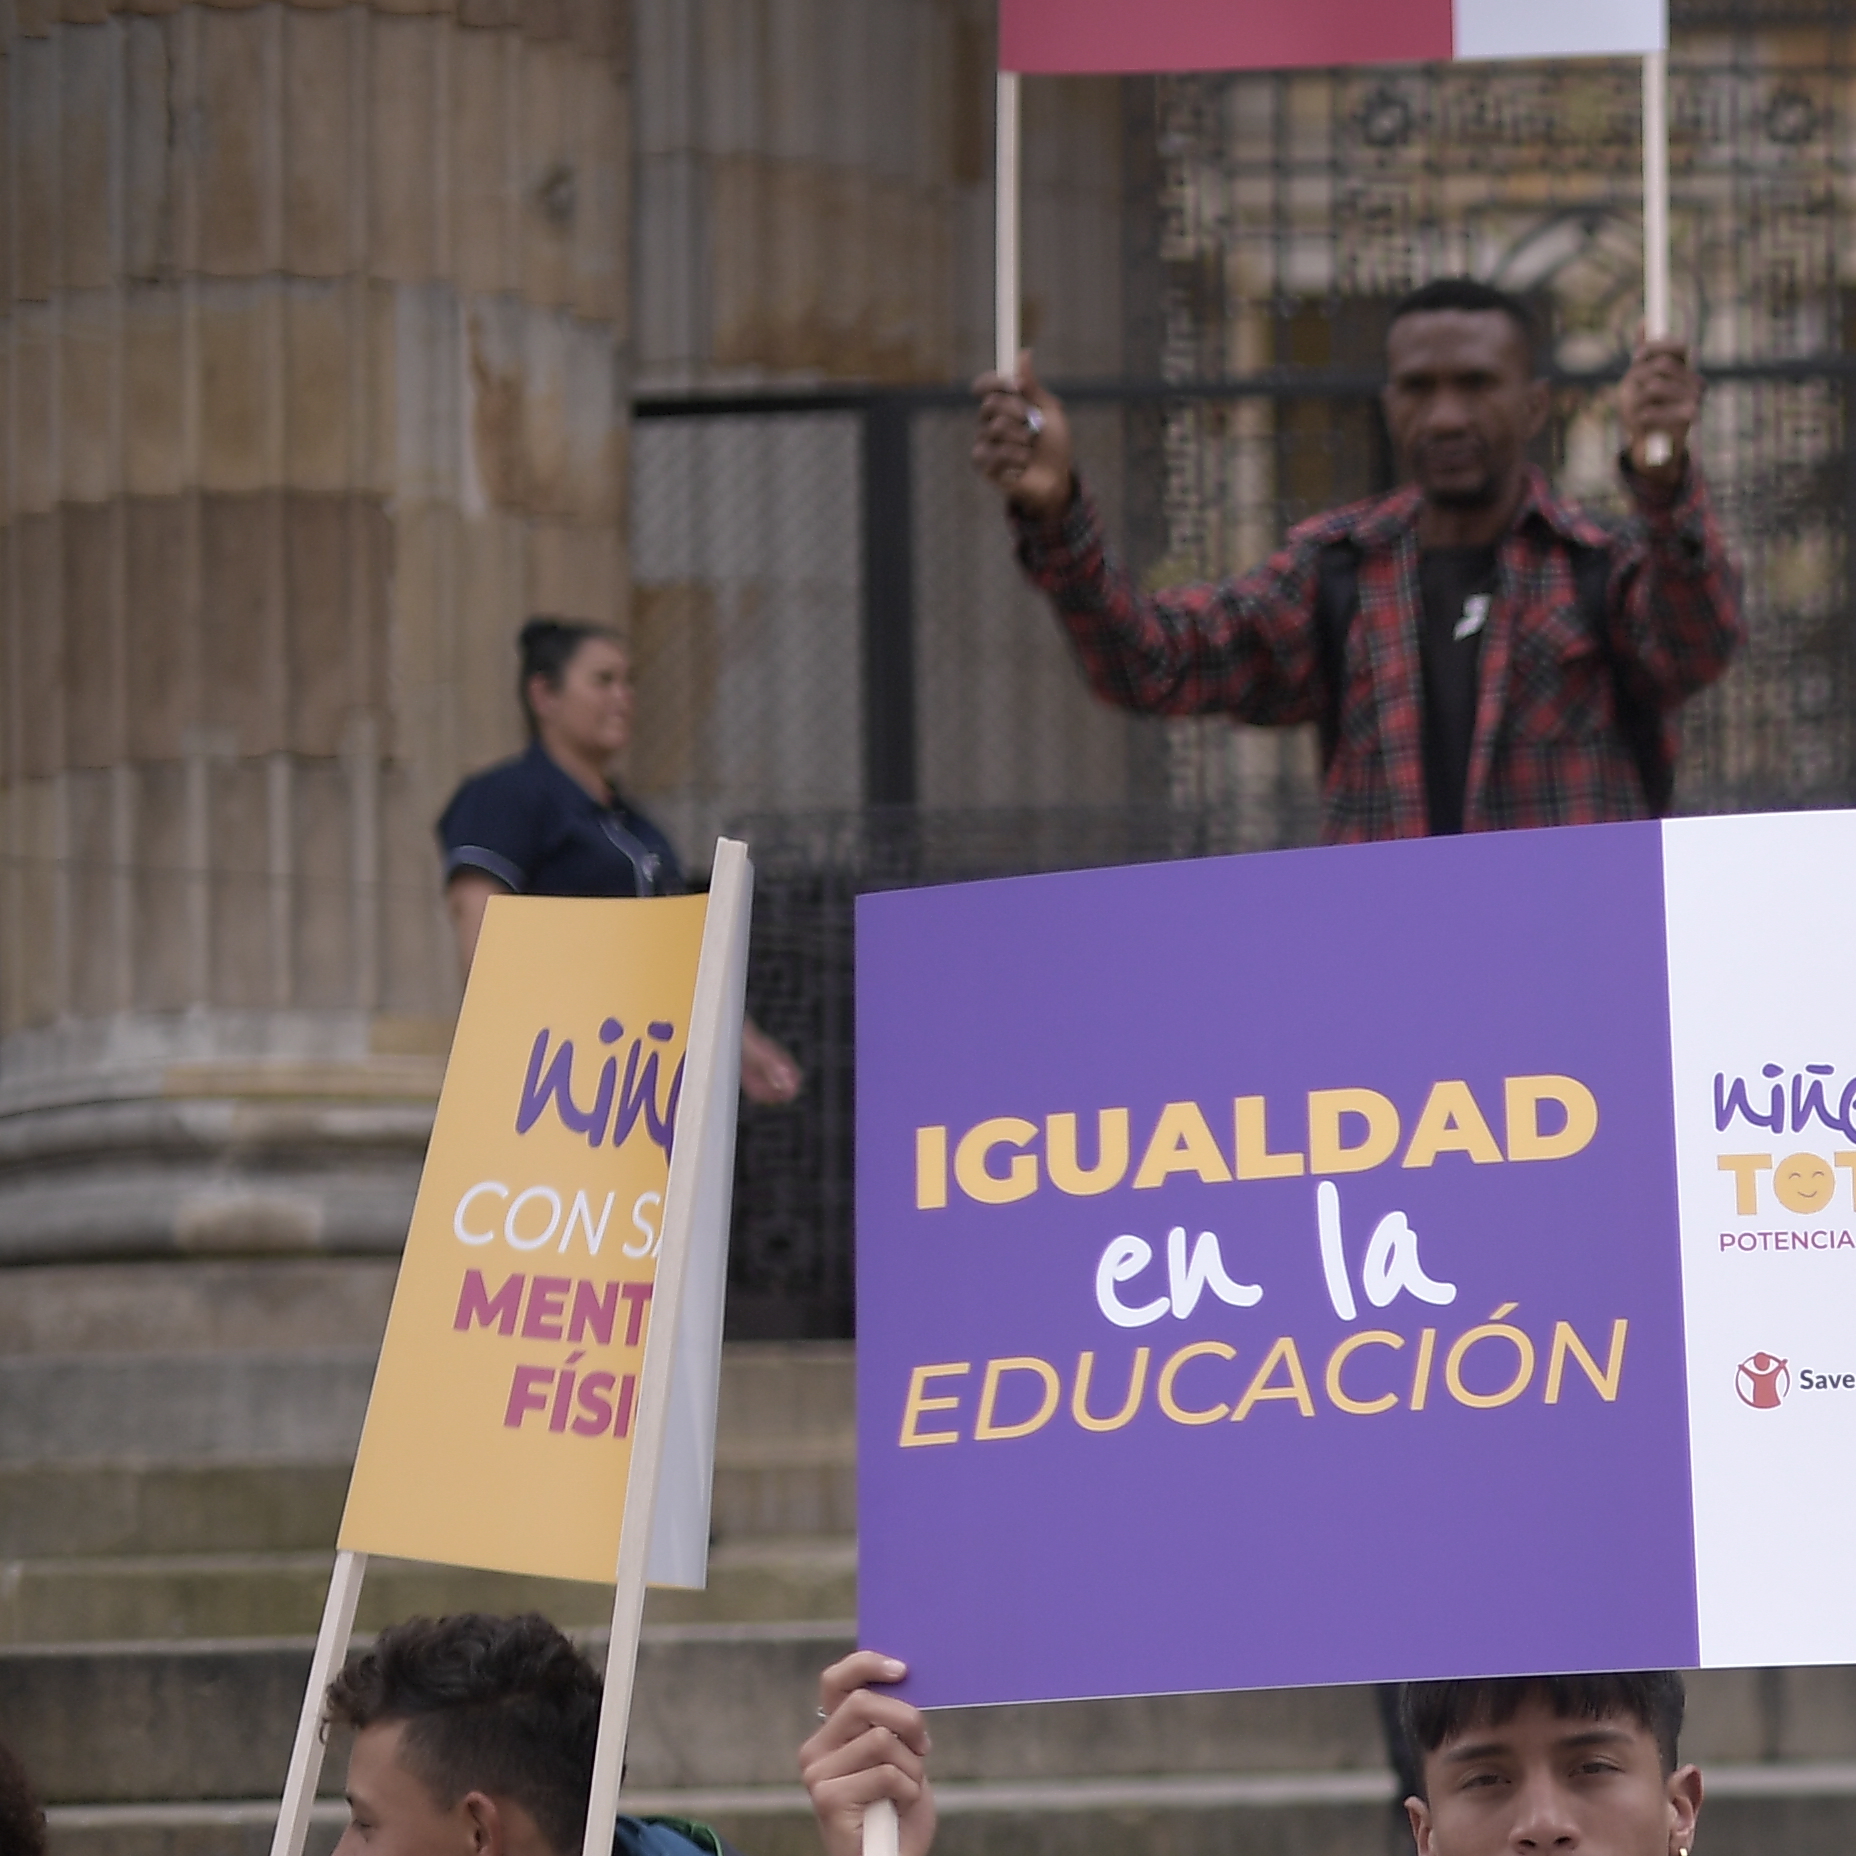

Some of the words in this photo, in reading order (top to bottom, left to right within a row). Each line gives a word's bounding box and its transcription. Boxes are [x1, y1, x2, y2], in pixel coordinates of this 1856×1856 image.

[515, 1017, 688, 1168] niñ
[916, 1073, 1599, 1211] IGUALDAD
[453, 1180, 616, 1257] CON
[622, 1190, 664, 1260] S
[1096, 1226, 1264, 1328] en
[1317, 1180, 1457, 1321] la
[1719, 1229, 1856, 1252] POTENCIA
[453, 1268, 654, 1347] MENT
[503, 1350, 640, 1440] FÍSI
[899, 1302, 1629, 1448] EDUCACIÓN
[1800, 1369, 1856, 1390] Save
